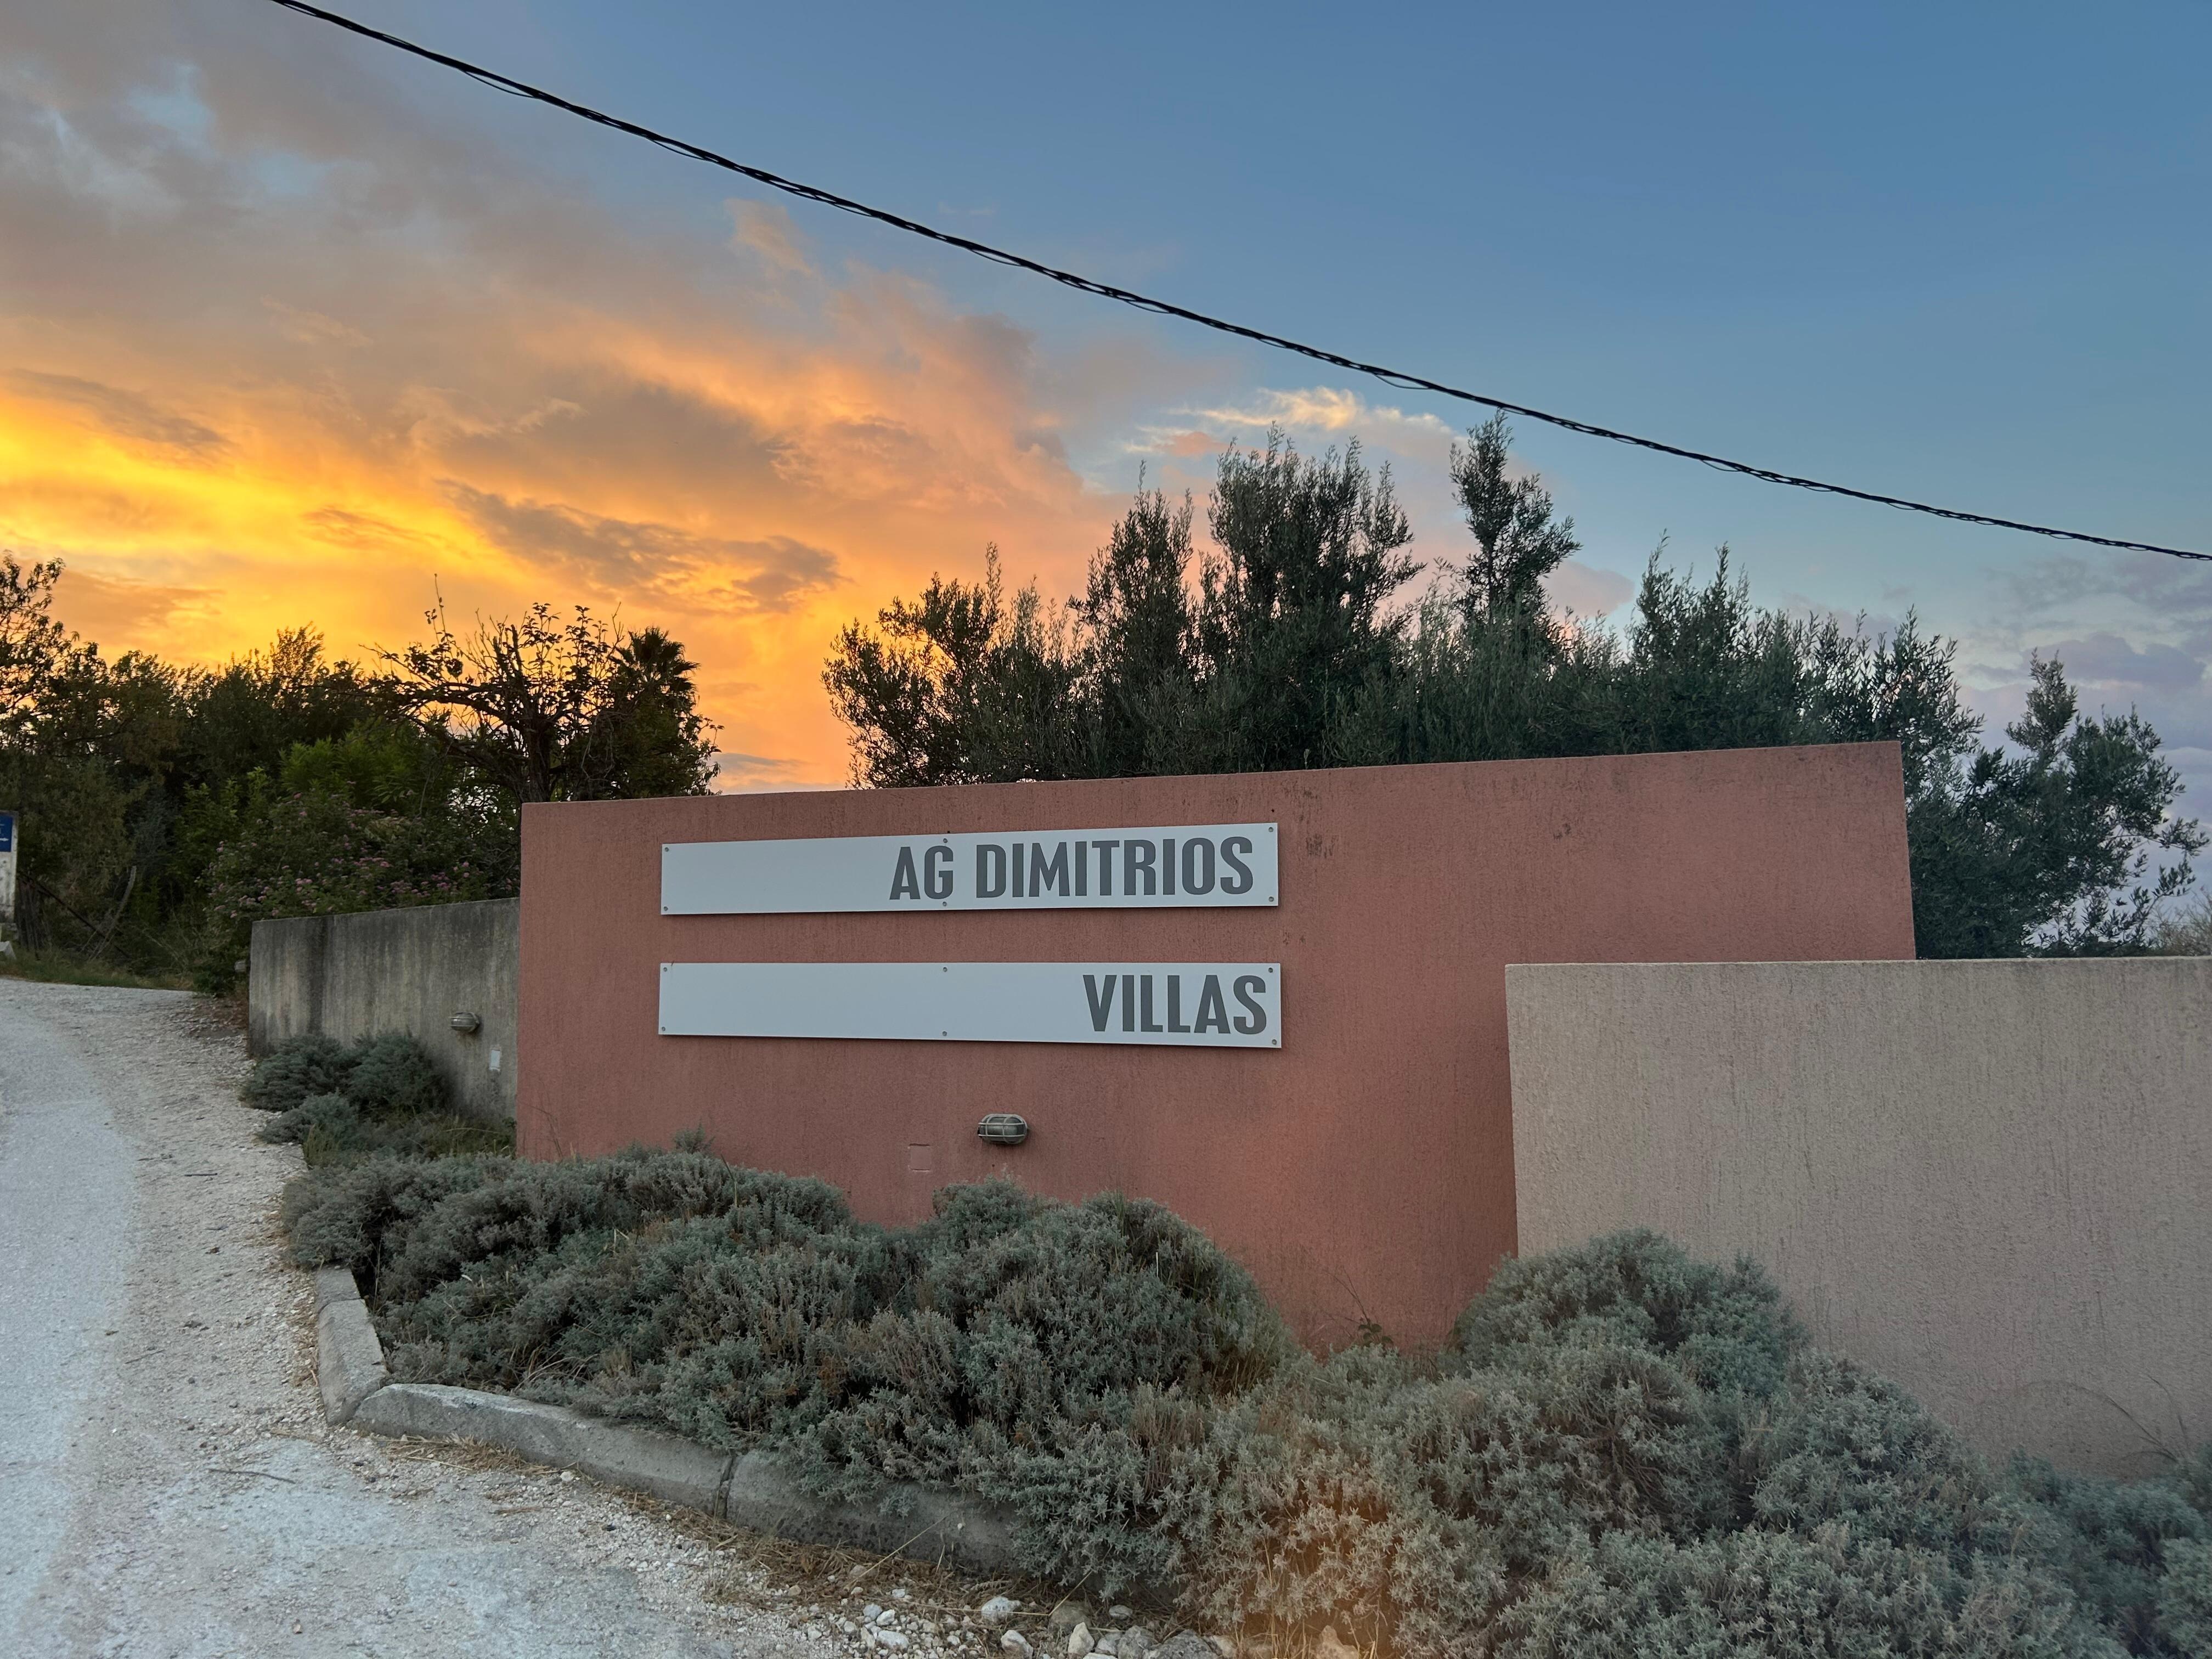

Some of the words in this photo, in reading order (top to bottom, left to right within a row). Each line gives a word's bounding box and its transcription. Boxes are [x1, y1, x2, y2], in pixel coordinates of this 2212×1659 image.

[889, 845, 954, 901] AG
[975, 836, 1254, 899] DIMITRIOS
[1082, 974, 1267, 1035] VILLAS
